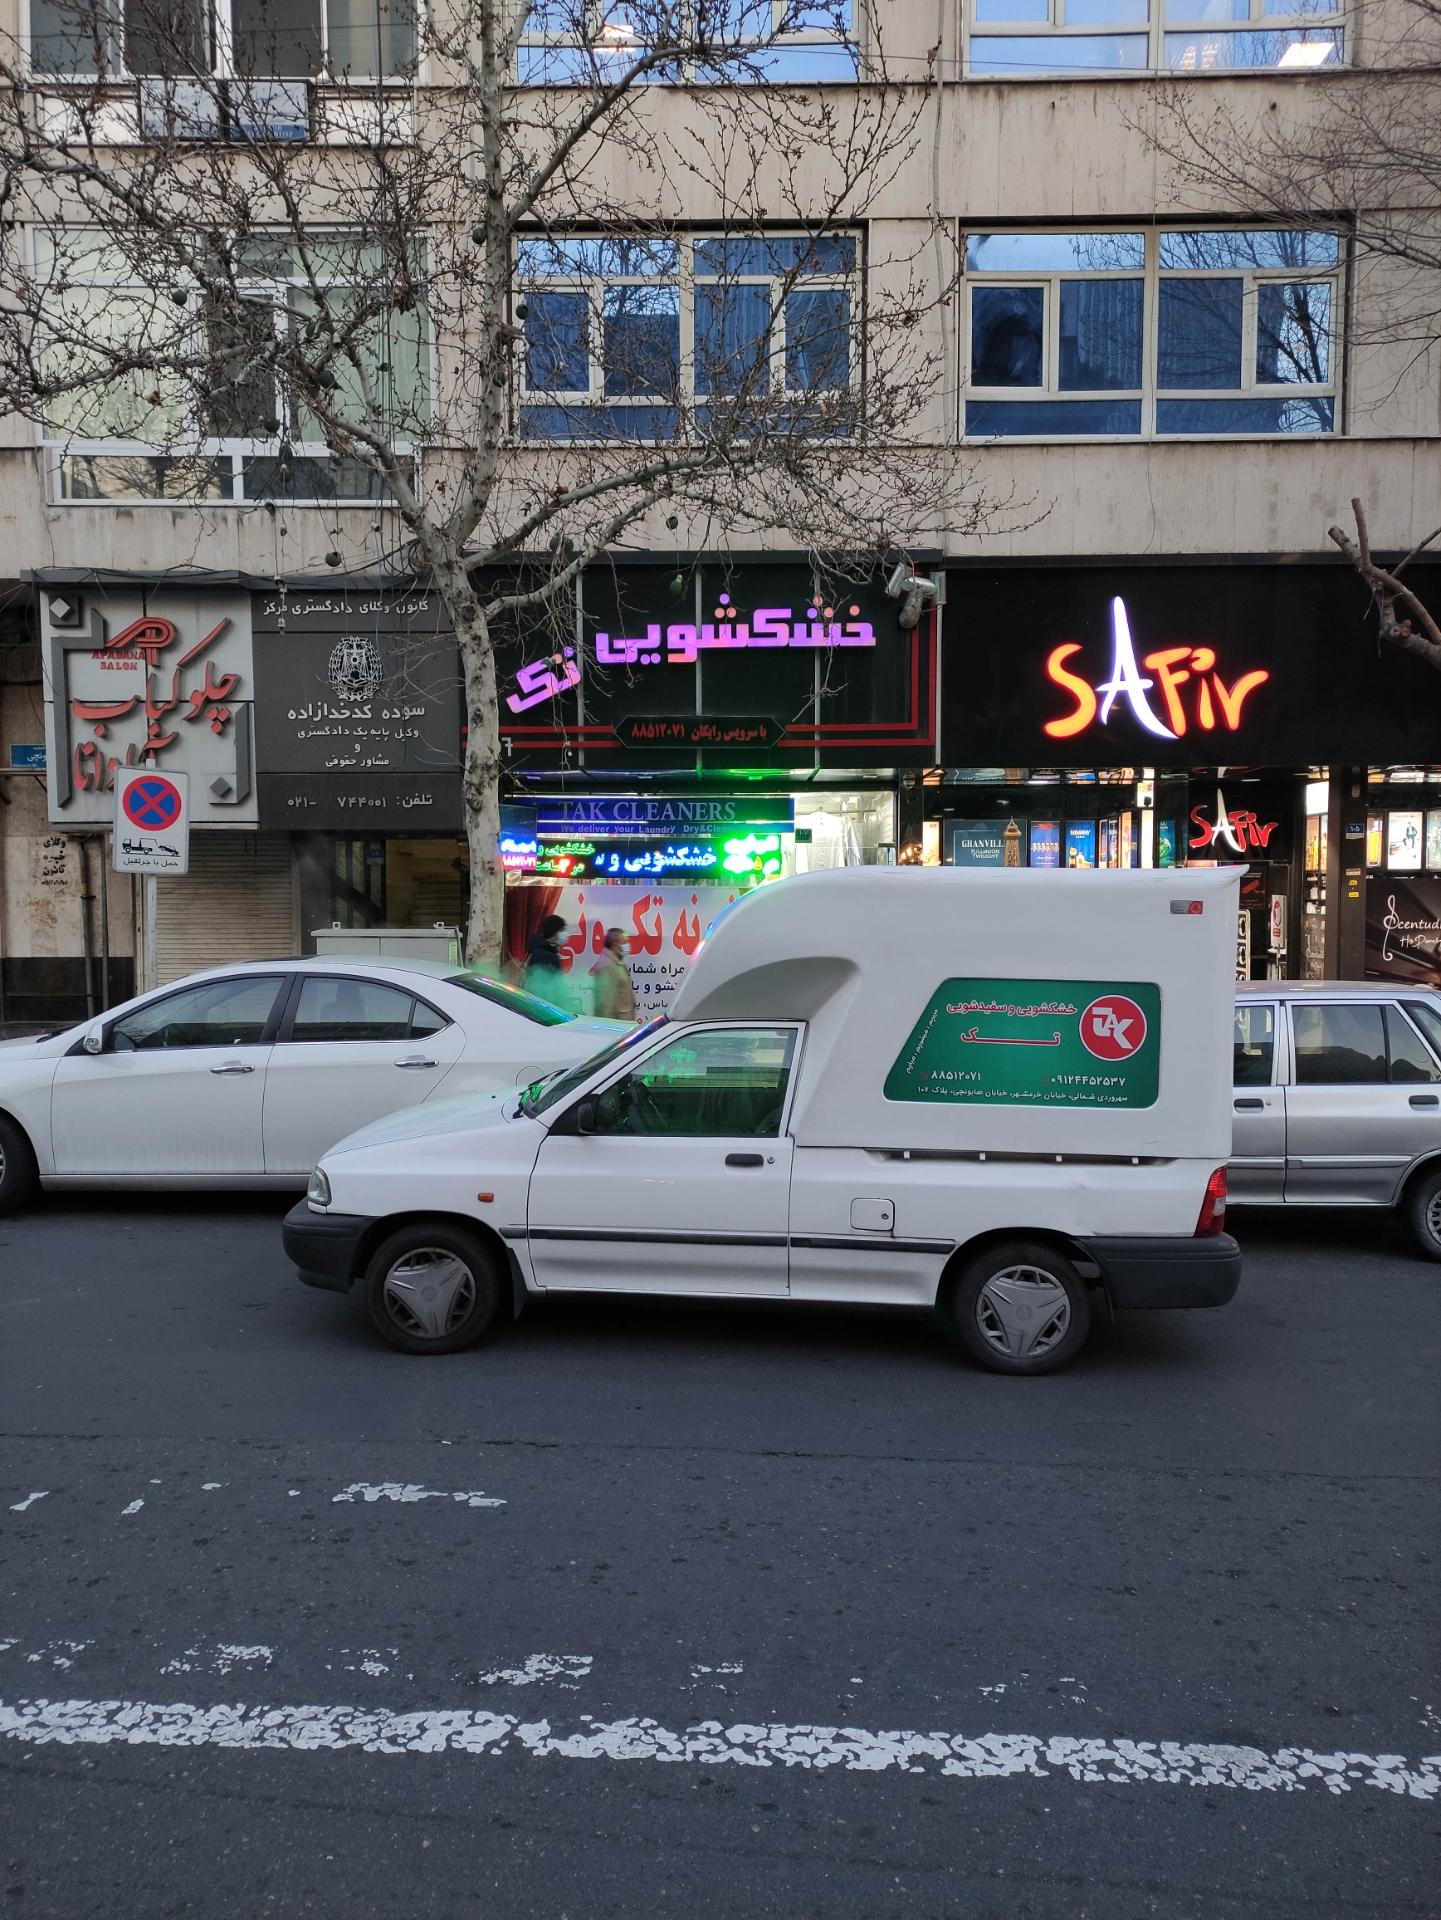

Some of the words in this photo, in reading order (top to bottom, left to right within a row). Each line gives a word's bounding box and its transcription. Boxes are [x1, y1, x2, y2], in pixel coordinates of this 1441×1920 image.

[263, 600, 288, 615] مرکز
[291, 599, 353, 615] دادگستری
[359, 600, 390, 614] وکلای
[396, 599, 429, 614] کانون
[595, 593, 876, 664] خشکشویی
[92, 650, 145, 660] APADANA
[100, 661, 138, 671] SALON
[505, 645, 581, 714] تک
[287, 702, 372, 721] کدخدازاده
[381, 705, 426, 720] سوده
[297, 725, 350, 739] دادگستری
[353, 727, 368, 740] یک
[370, 727, 390, 742] پایه
[394, 728, 419, 742] وکیل
[631, 722, 685, 738] ۸۸۵۱۲۰۷۱
[691, 723, 722, 741] رایگان
[723, 727, 758, 741] سرویس
[759, 723, 767, 741] با
[354, 742, 361, 752] و
[325, 754, 357, 767] حقوقی
[360, 753, 390, 767] مشاور
[558, 801, 606, 820] TAK
[613, 801, 736, 821] CLEANERS
[561, 824, 575, 833] We
[578, 824, 609, 833] deliver
[961, 839, 1005, 848] GRANVILL
[123, 857, 151, 866] جرثقیل
[153, 858, 159, 866] با
[160, 859, 179, 868] حمل
[624, 846, 717, 873] خشکشویی
[660, 963, 685, 975] مراه
[644, 984, 651, 995] و
[946, 998, 1007, 1015] سفیدشویی
[1007, 1004, 1016, 1017] و
[1017, 1001, 1078, 1017] خشکشویی
[931, 1070, 981, 1081] ۸۸۵۱۲۰۷۱
[1050, 1075, 1126, 1086] ۰۹۱۲۴۴۵۲۵۳۷
[931, 1086, 948, 1095] پلاک
[985, 1089, 1008, 1098] خیابان
[1043, 1091, 1067, 1100] خیابان
[1097, 1094, 1128, 1102] سهروردی
